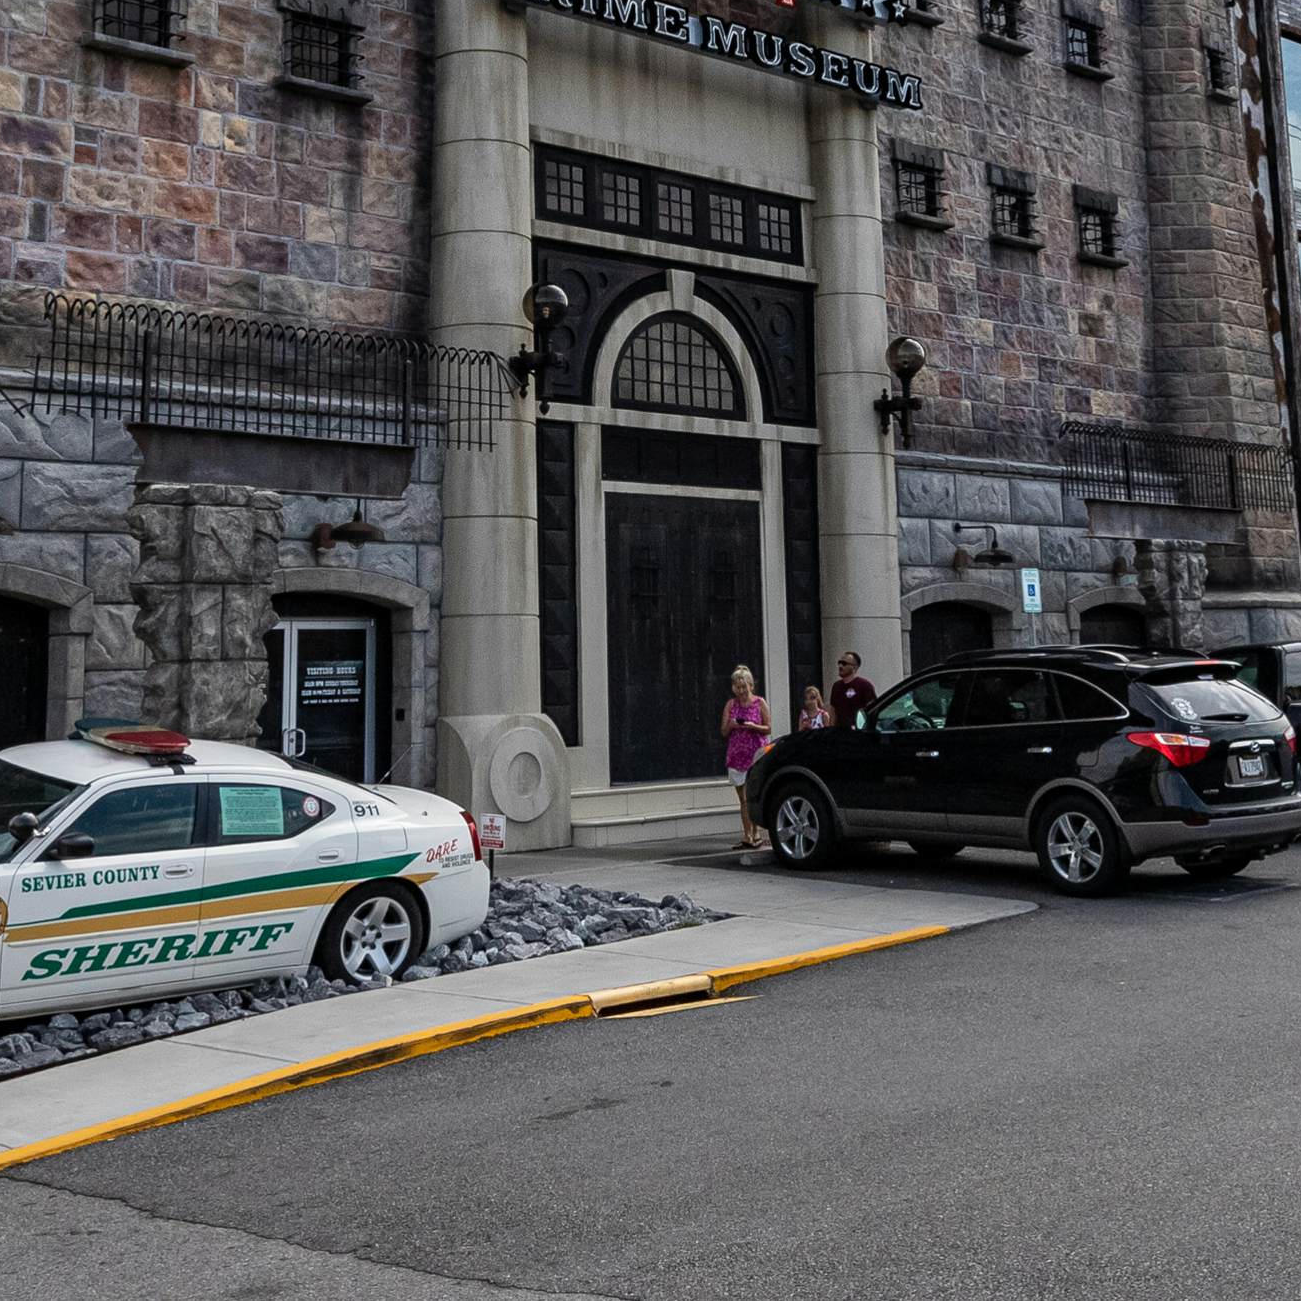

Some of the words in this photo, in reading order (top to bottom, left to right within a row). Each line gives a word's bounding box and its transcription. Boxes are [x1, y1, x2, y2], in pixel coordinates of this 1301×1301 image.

[705, 16, 923, 110] MUSEUM
[353, 804, 380, 817] 911
[426, 838, 459, 863] DARE
[21, 873, 87, 893] SEVIER
[93, 865, 160, 885] COUNTY
[21, 922, 295, 982] SHERIFF
